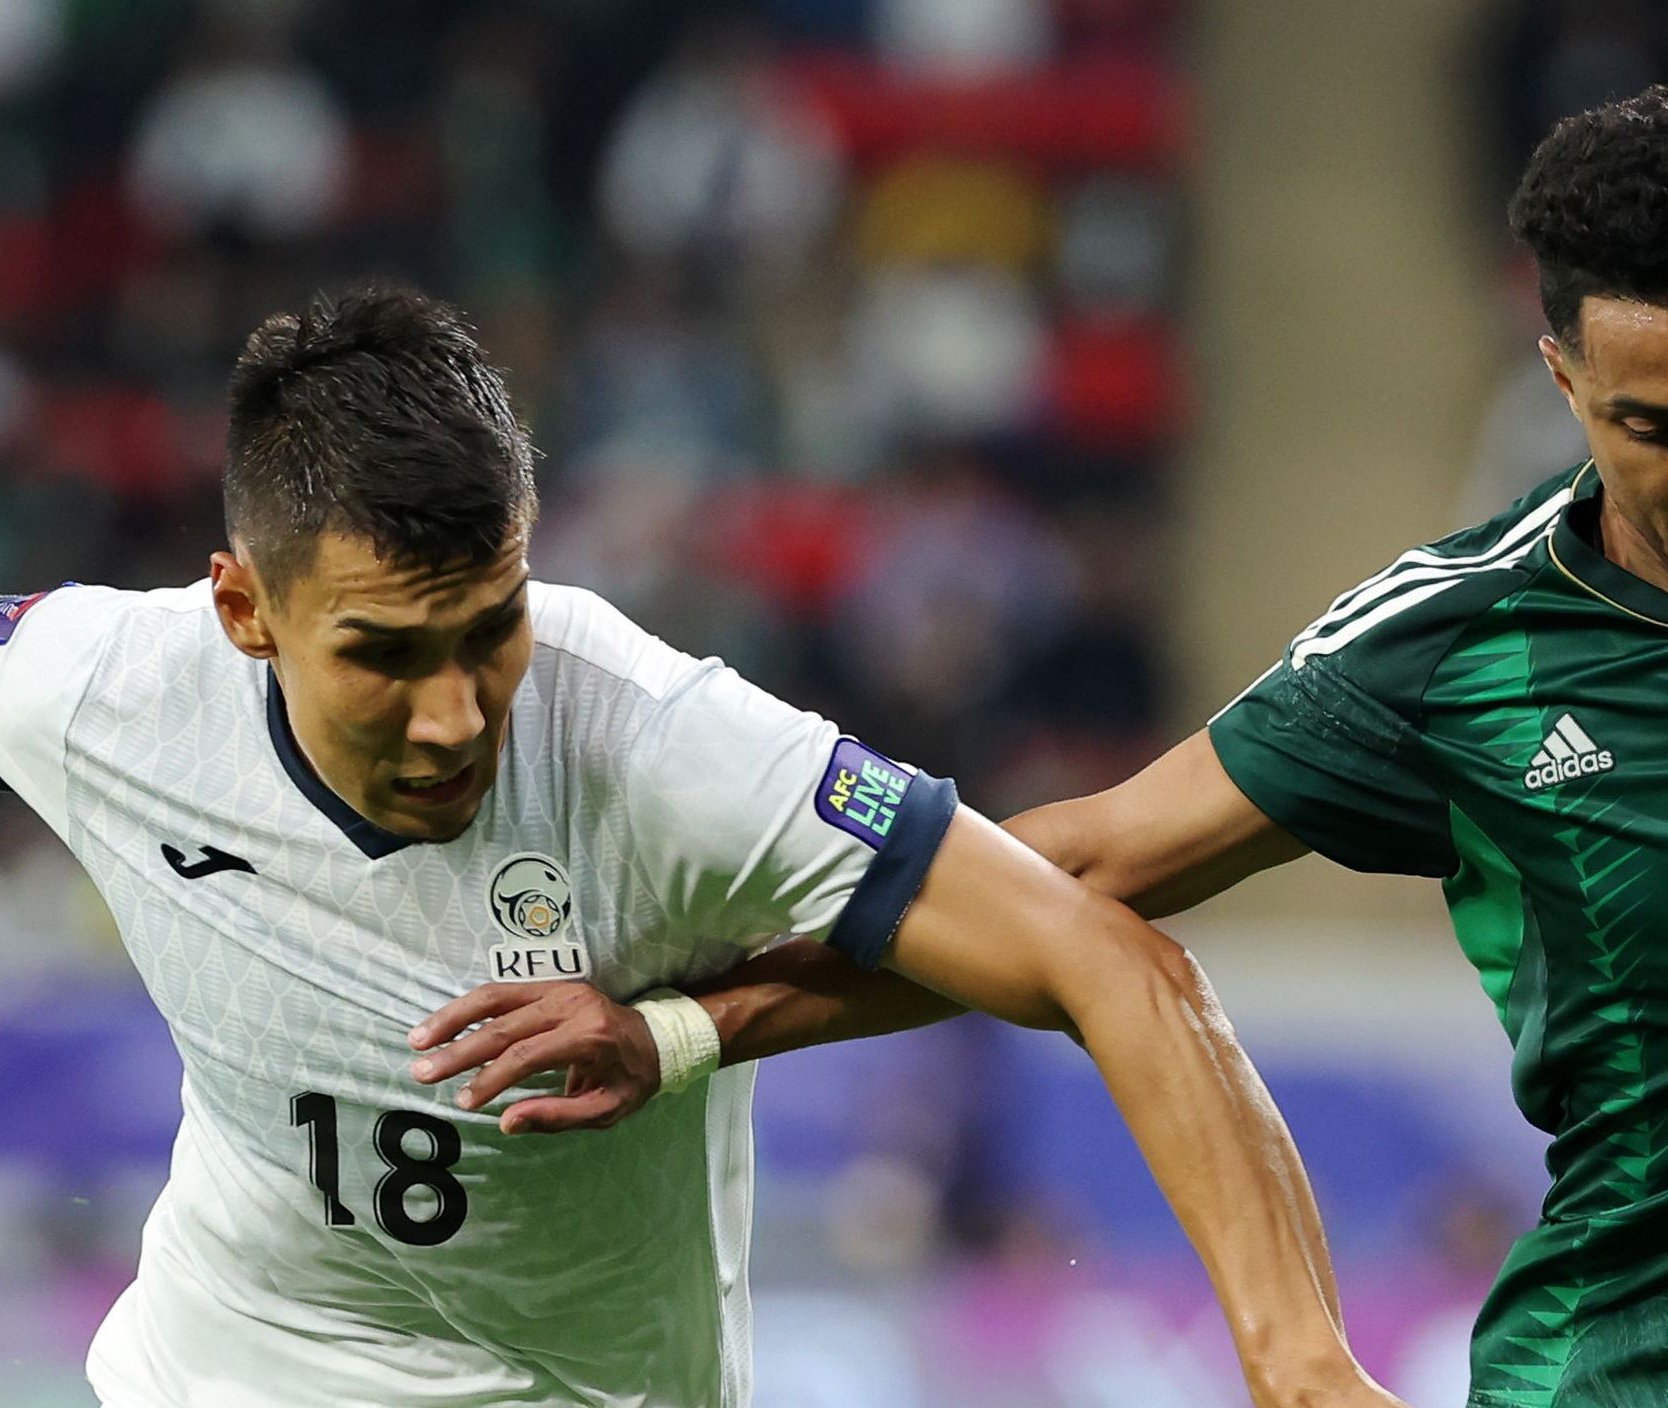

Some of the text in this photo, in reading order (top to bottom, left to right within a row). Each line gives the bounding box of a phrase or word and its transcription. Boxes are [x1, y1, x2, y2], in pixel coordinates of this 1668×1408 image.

[828, 768, 858, 813] AFC
[1524, 750, 1614, 789] adidas
[845, 759, 890, 828] LIVE
[495, 948, 582, 978] KFU
[289, 1090, 469, 1247] 18
